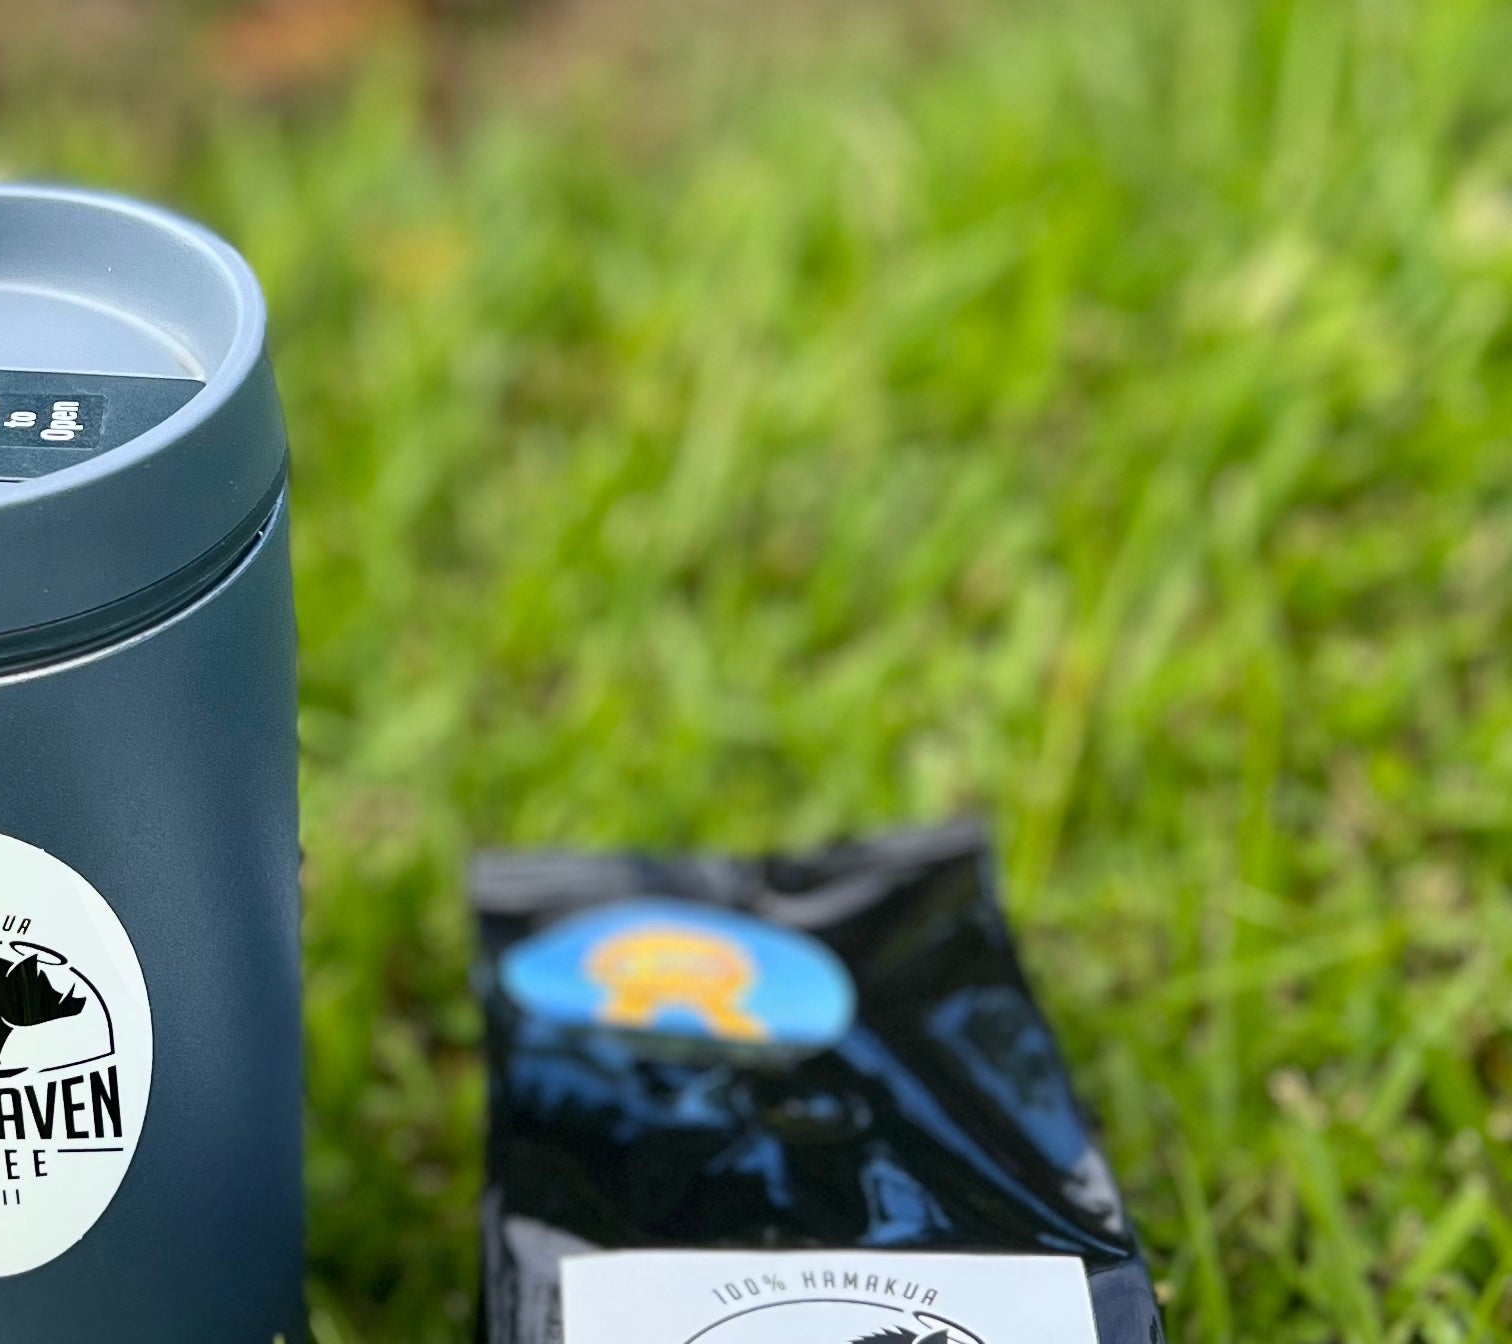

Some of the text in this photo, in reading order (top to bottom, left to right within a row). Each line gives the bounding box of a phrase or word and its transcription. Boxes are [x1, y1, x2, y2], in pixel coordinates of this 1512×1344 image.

[3, 411, 37, 428] to
[40, 401, 84, 441] Open
[711, 1270, 939, 1306] 100% HAMAKUA
